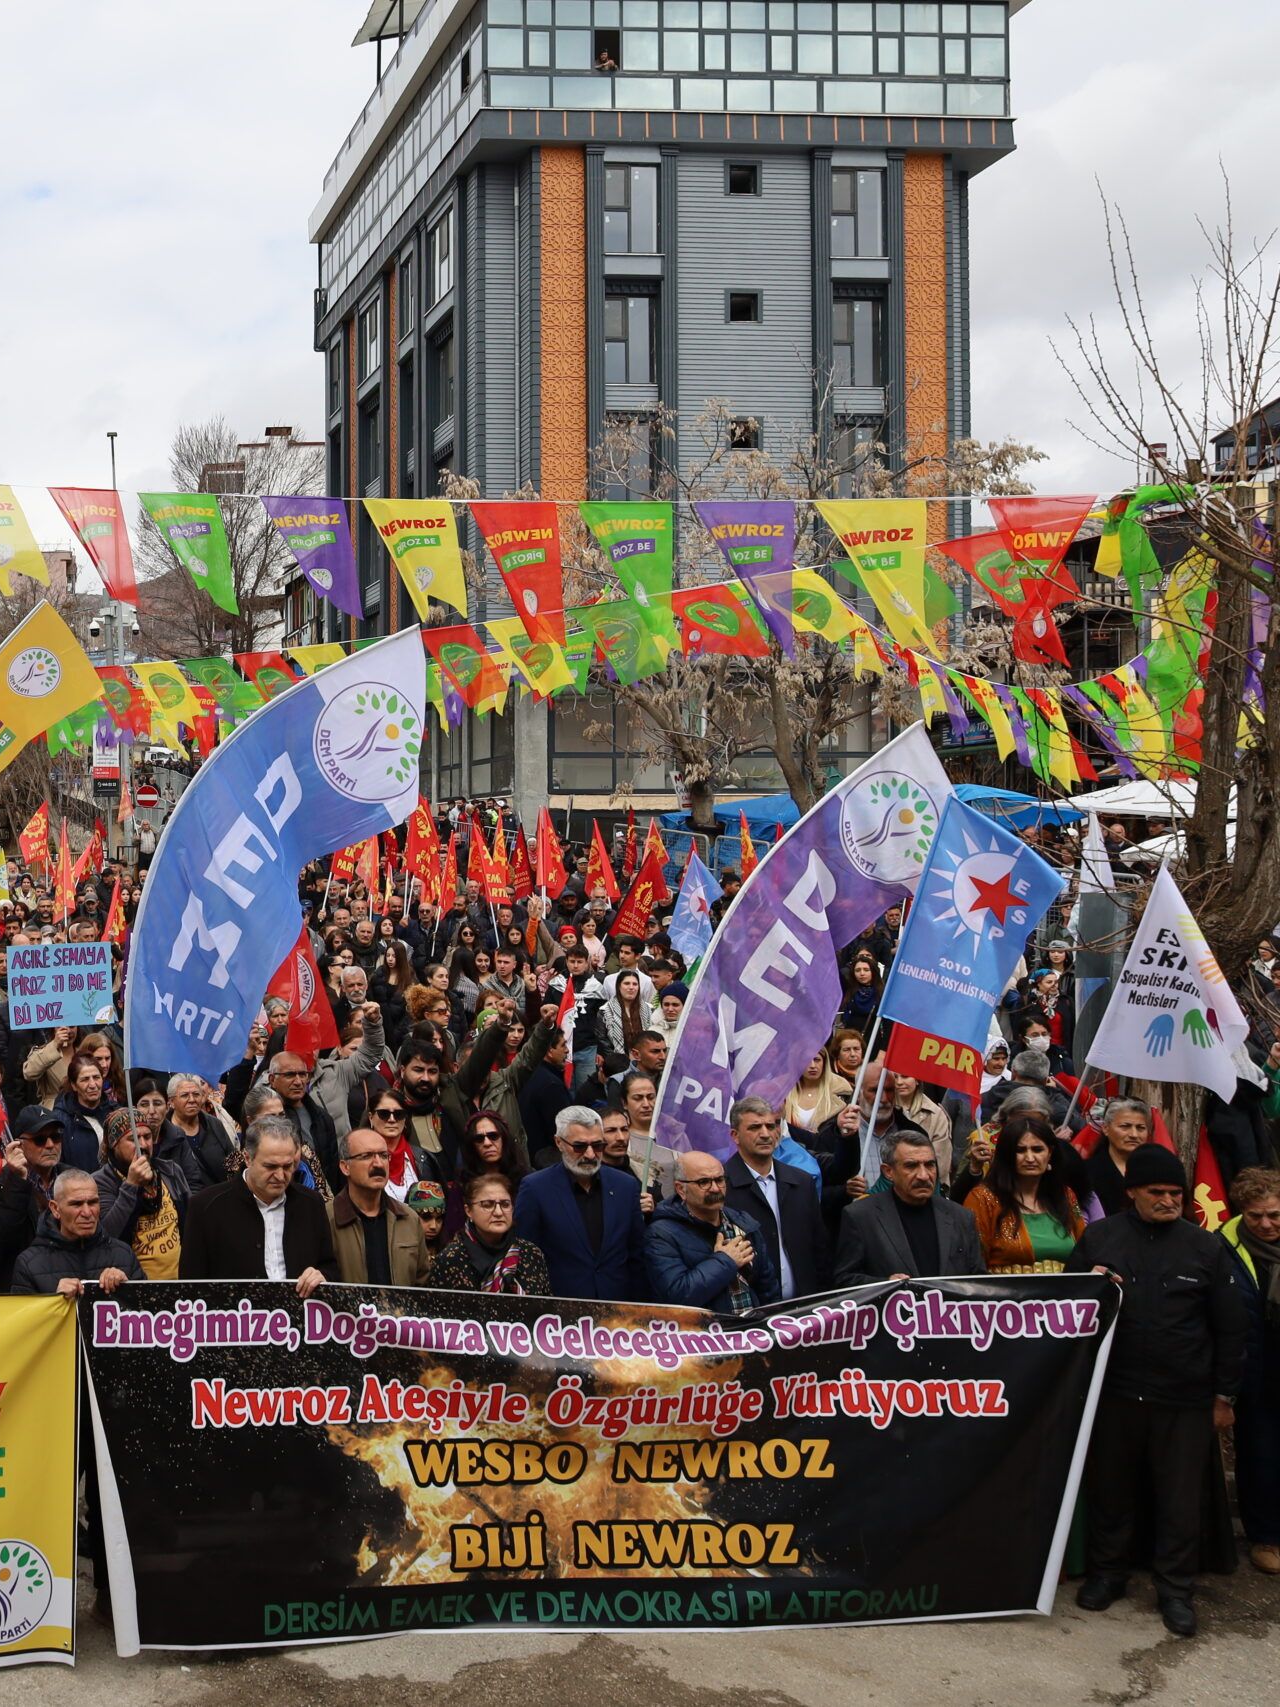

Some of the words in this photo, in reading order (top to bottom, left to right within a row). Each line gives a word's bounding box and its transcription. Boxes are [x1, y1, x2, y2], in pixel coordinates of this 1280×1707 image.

[152, 507, 215, 520] NEWROZ
[273, 513, 341, 528] NEWROZ
[195, 525, 208, 533] BE
[319, 534, 332, 542] BE
[380, 518, 446, 537] NEWROZ
[711, 525, 784, 540] NEWROZ
[424, 537, 436, 545] BE
[637, 540, 651, 551] BE
[753, 549, 768, 559] BE
[881, 556, 896, 567] BE
[0, 733, 11, 747] BE
[320, 729, 331, 765] DEM
[328, 763, 358, 793] PARTİ
[844, 820, 857, 848] DEM
[849, 845, 877, 872] PARTİ
[168, 751, 303, 989] DEM
[53, 946, 107, 967] SEMAYA
[939, 957, 972, 976] 2010
[711, 849, 838, 1092] DEM
[1121, 969, 1169, 987] Sosyalist
[52, 975, 64, 992] JI
[69, 973, 84, 992] BO
[87, 971, 107, 991] ME
[939, 975, 980, 997] SOSYALİST
[1127, 989, 1180, 1010] Meclisleri
[36, 1002, 63, 1022] DOZ
[919, 1037, 980, 1078] PAR
[95, 1300, 299, 1361] Emeğimize,
[305, 1300, 487, 1358] Doğamıza
[491, 1321, 530, 1357] ve
[534, 1317, 771, 1369] Geleceğimize
[772, 1299, 877, 1350] Sahip
[884, 1290, 1099, 1351] Çıkıyoruz
[192, 1378, 350, 1428] Newroz
[359, 1374, 526, 1433] Ateşiyle
[547, 1374, 762, 1437] Özgürlüğe
[771, 1368, 1008, 1429] Yürüyoruz
[407, 1441, 585, 1485] WESBO
[616, 1438, 835, 1481] NEWROZ
[577, 1523, 799, 1566] NEWROZ
[264, 1591, 379, 1636] DERSİM
[390, 1594, 474, 1627] EMEK
[487, 1592, 525, 1624] VE
[537, 1583, 739, 1623] DEMOKRASİ
[748, 1584, 939, 1621] PLATFORMU
[0, 1617, 32, 1640] PARTİ
